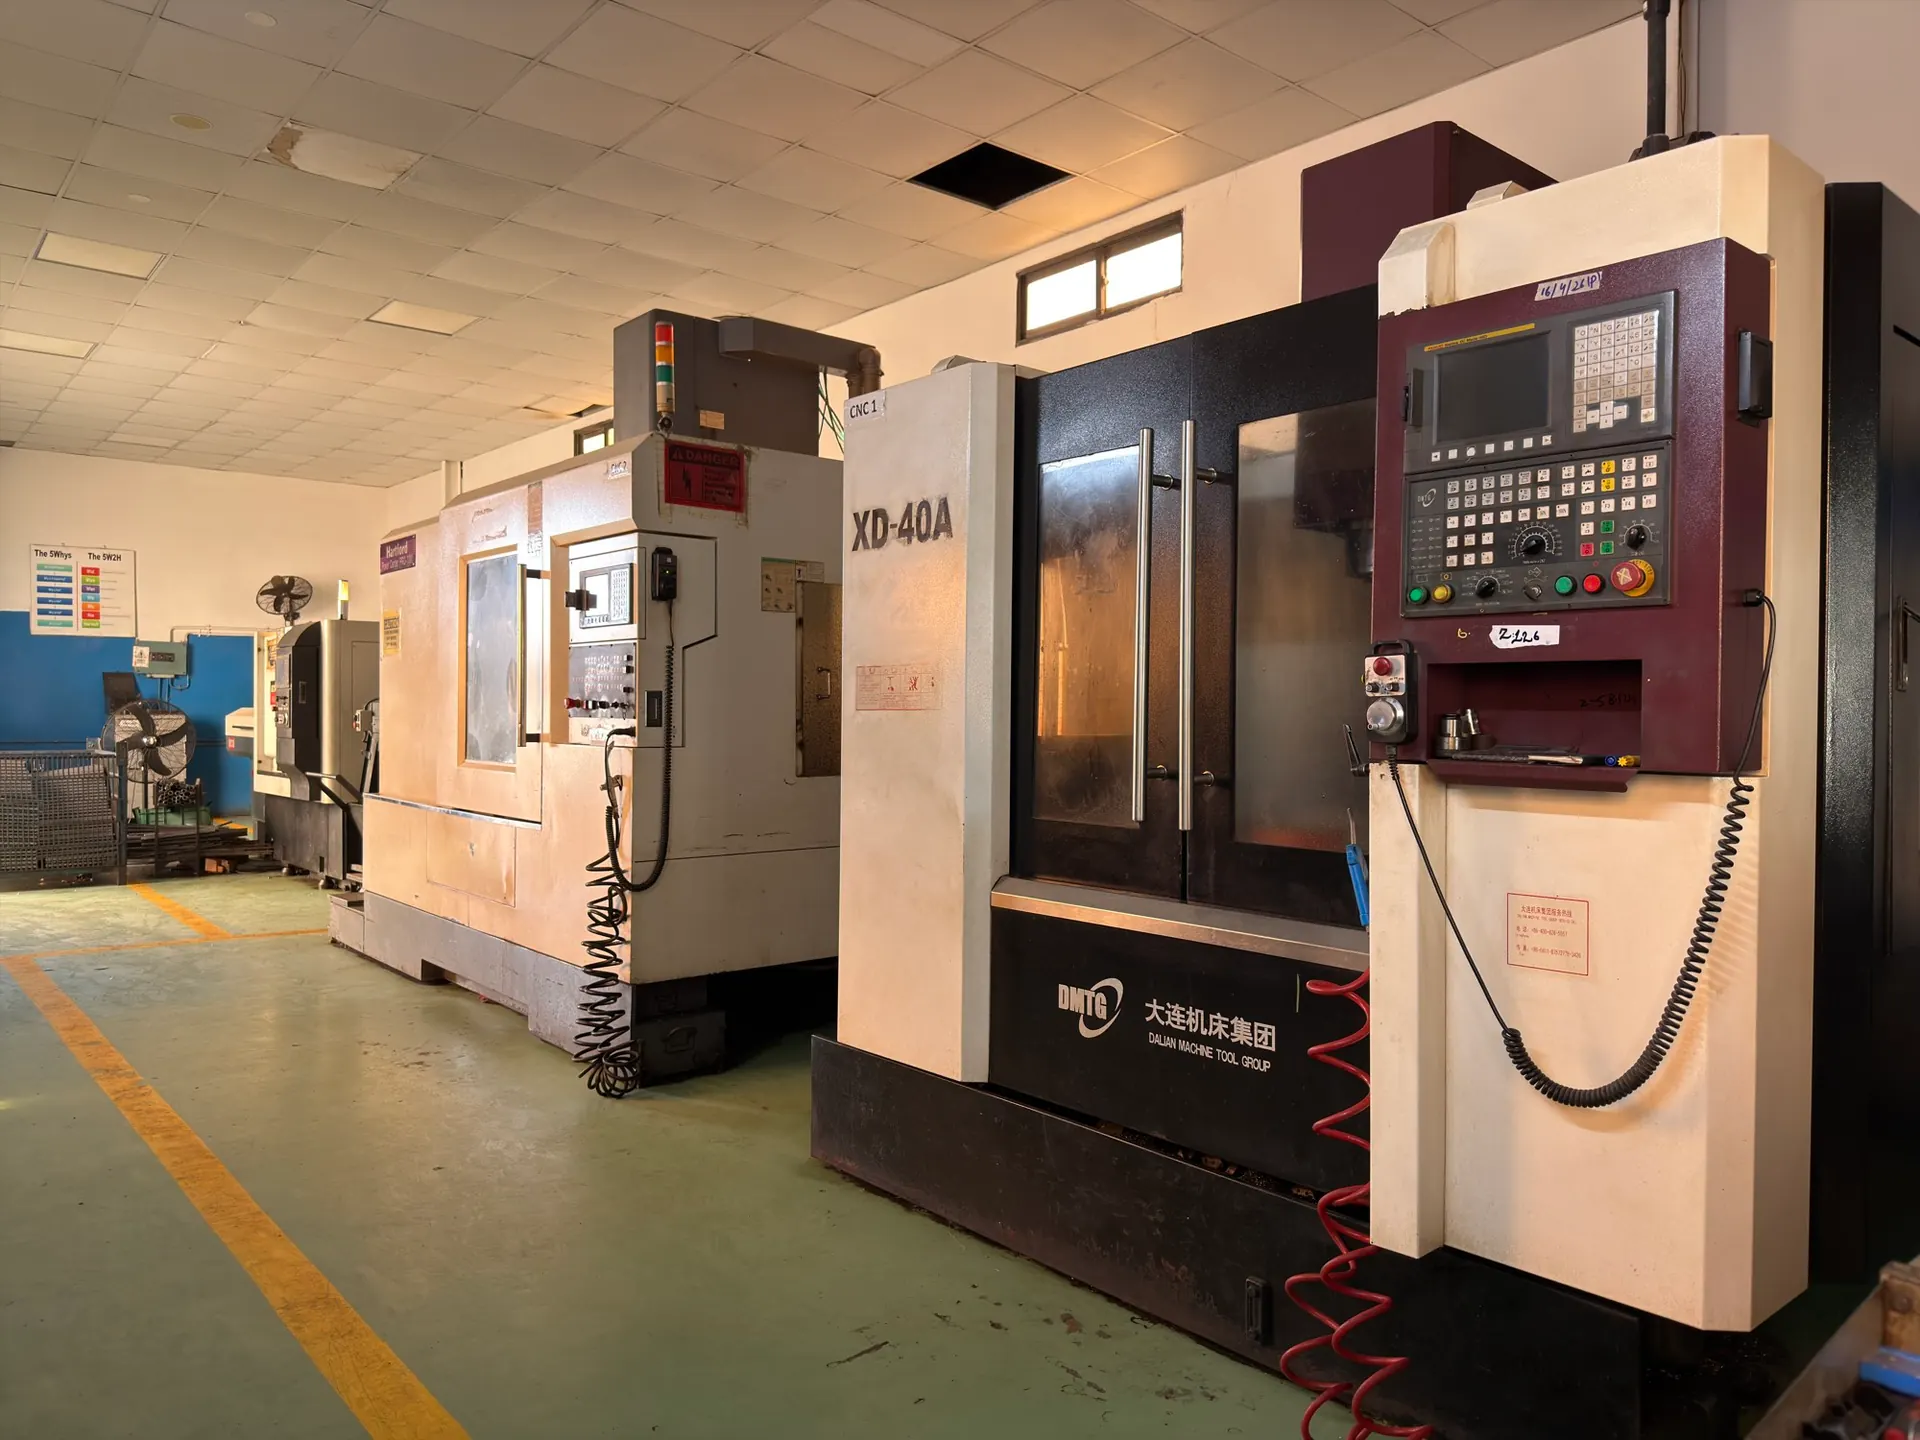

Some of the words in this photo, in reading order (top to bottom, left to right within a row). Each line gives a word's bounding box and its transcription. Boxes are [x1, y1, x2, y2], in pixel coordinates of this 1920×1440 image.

[849, 401, 869, 419] CNC
[871, 399, 878, 413] 1
[686, 449, 740, 467] DANGER
[851, 496, 953, 552] XD-40A
[34, 549, 48, 558] The
[49, 550, 72, 560] 5Whys
[87, 552, 101, 561] The
[102, 553, 122, 562] 5W2H
[1058, 983, 1108, 1020] DMTG
[1144, 998, 1276, 1052] 大连机床集团
[1148, 1031, 1177, 1050] DALIAN
[1178, 1039, 1214, 1059] MACHINE
[1215, 1048, 1239, 1066] TOOL
[1241, 1055, 1271, 1073] GROUP
